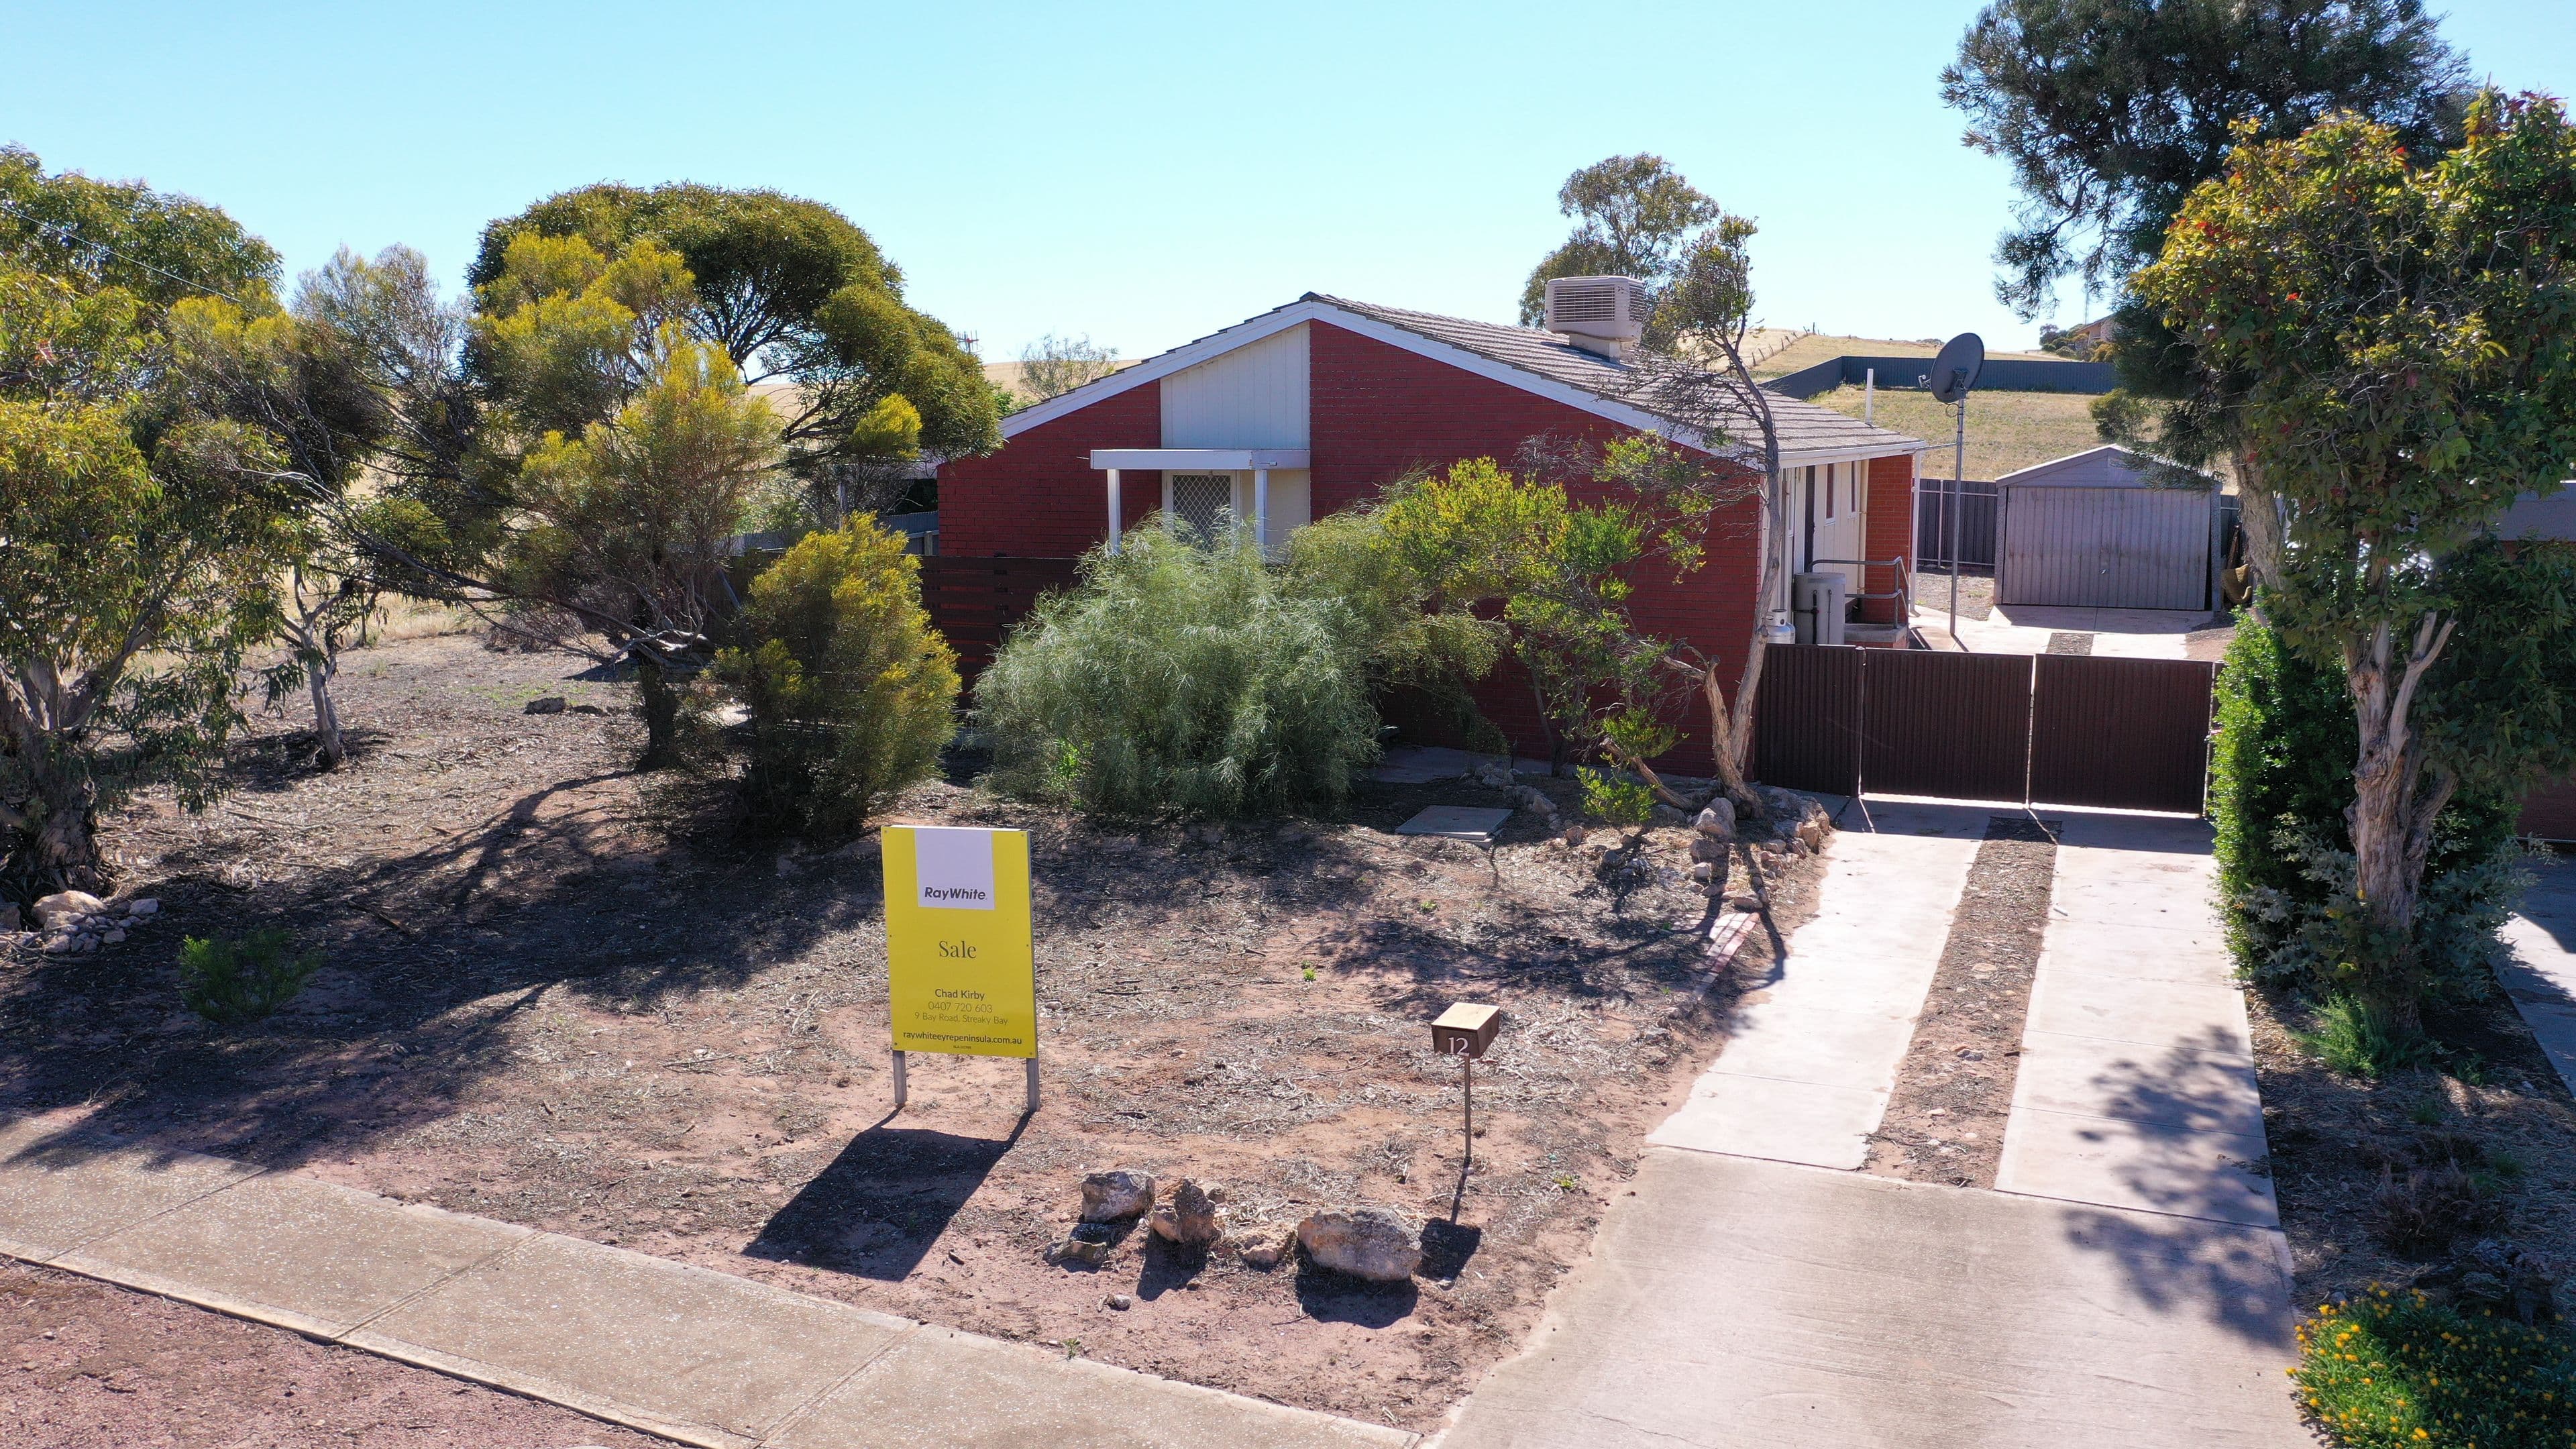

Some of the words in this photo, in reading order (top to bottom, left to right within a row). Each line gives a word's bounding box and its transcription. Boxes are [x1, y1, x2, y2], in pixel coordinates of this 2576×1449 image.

[924, 887, 986, 900] RayWhite
[939, 941, 977, 959] Sale
[934, 989, 958, 998] Chad
[961, 990, 985, 1001] Kirby
[928, 1001, 951, 1011] 0407
[955, 1003, 972, 1012] 720
[975, 1004, 993, 1014] 603
[922, 1012, 936, 1022] Bay
[962, 1014, 991, 1025] Streaky
[994, 1016, 1008, 1026] Bay
[903, 1031, 1022, 1044] raywhiteeyrepeninsula.com.au
[1448, 1036, 1470, 1057] 12
